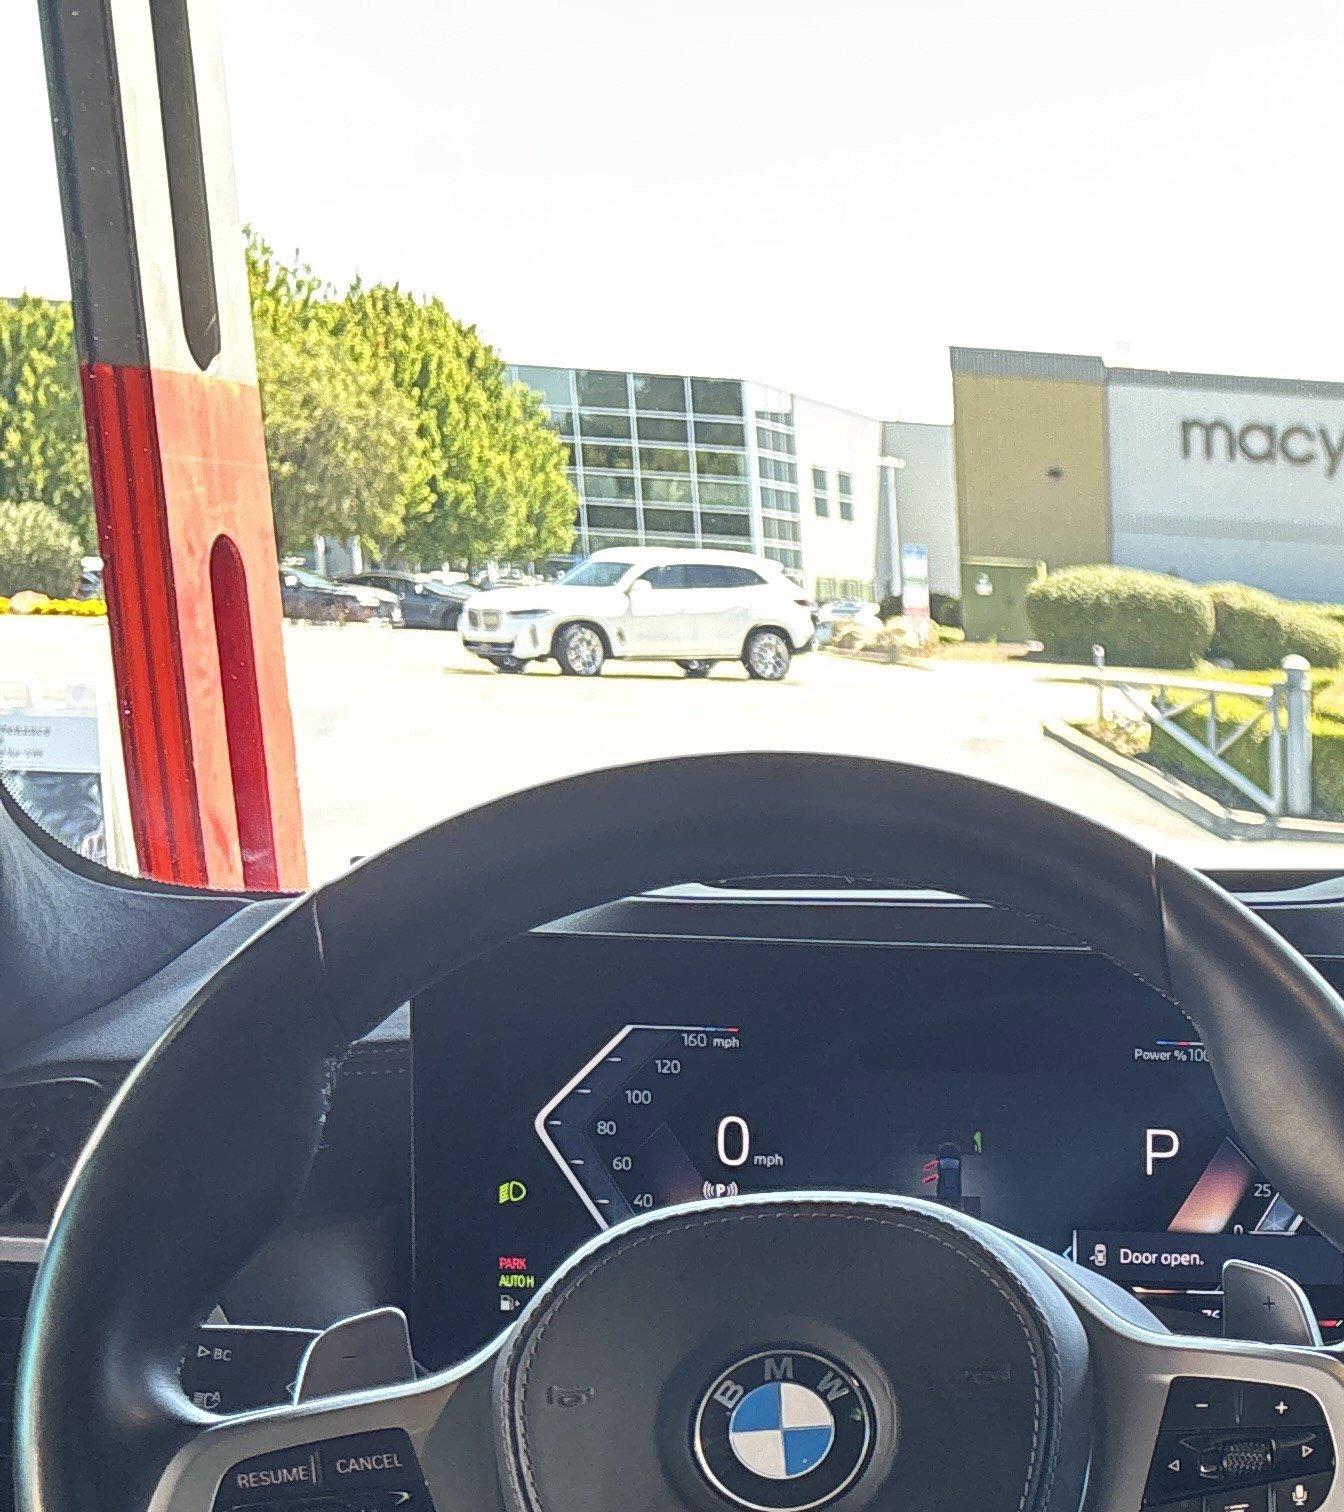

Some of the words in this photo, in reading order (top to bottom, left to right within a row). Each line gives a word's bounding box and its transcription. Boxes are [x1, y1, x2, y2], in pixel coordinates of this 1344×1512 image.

[681, 1033, 707, 1048] 160
[712, 1036, 740, 1049] mph
[1134, 1048, 1172, 1061] Power
[654, 1060, 681, 1075] 120
[625, 1090, 651, 1105] 100
[596, 1120, 617, 1135] 80
[716, 1115, 750, 1167] 0
[1145, 1128, 1180, 1176] P
[612, 1156, 632, 1171] 60
[753, 1154, 784, 1168] mph
[1253, 1183, 1272, 1198] 25
[633, 1193, 654, 1208] 40
[499, 1257, 527, 1270] PARK
[1120, 1248, 1158, 1265] Door
[1161, 1251, 1204, 1267] open.
[499, 1275, 525, 1288] AUTO
[527, 1276, 535, 1288] H
[213, 1348, 232, 1362] BC
[714, 1356, 849, 1409] BMW
[336, 1454, 403, 1475] CANCEL
[237, 1465, 309, 1489] RESUME
